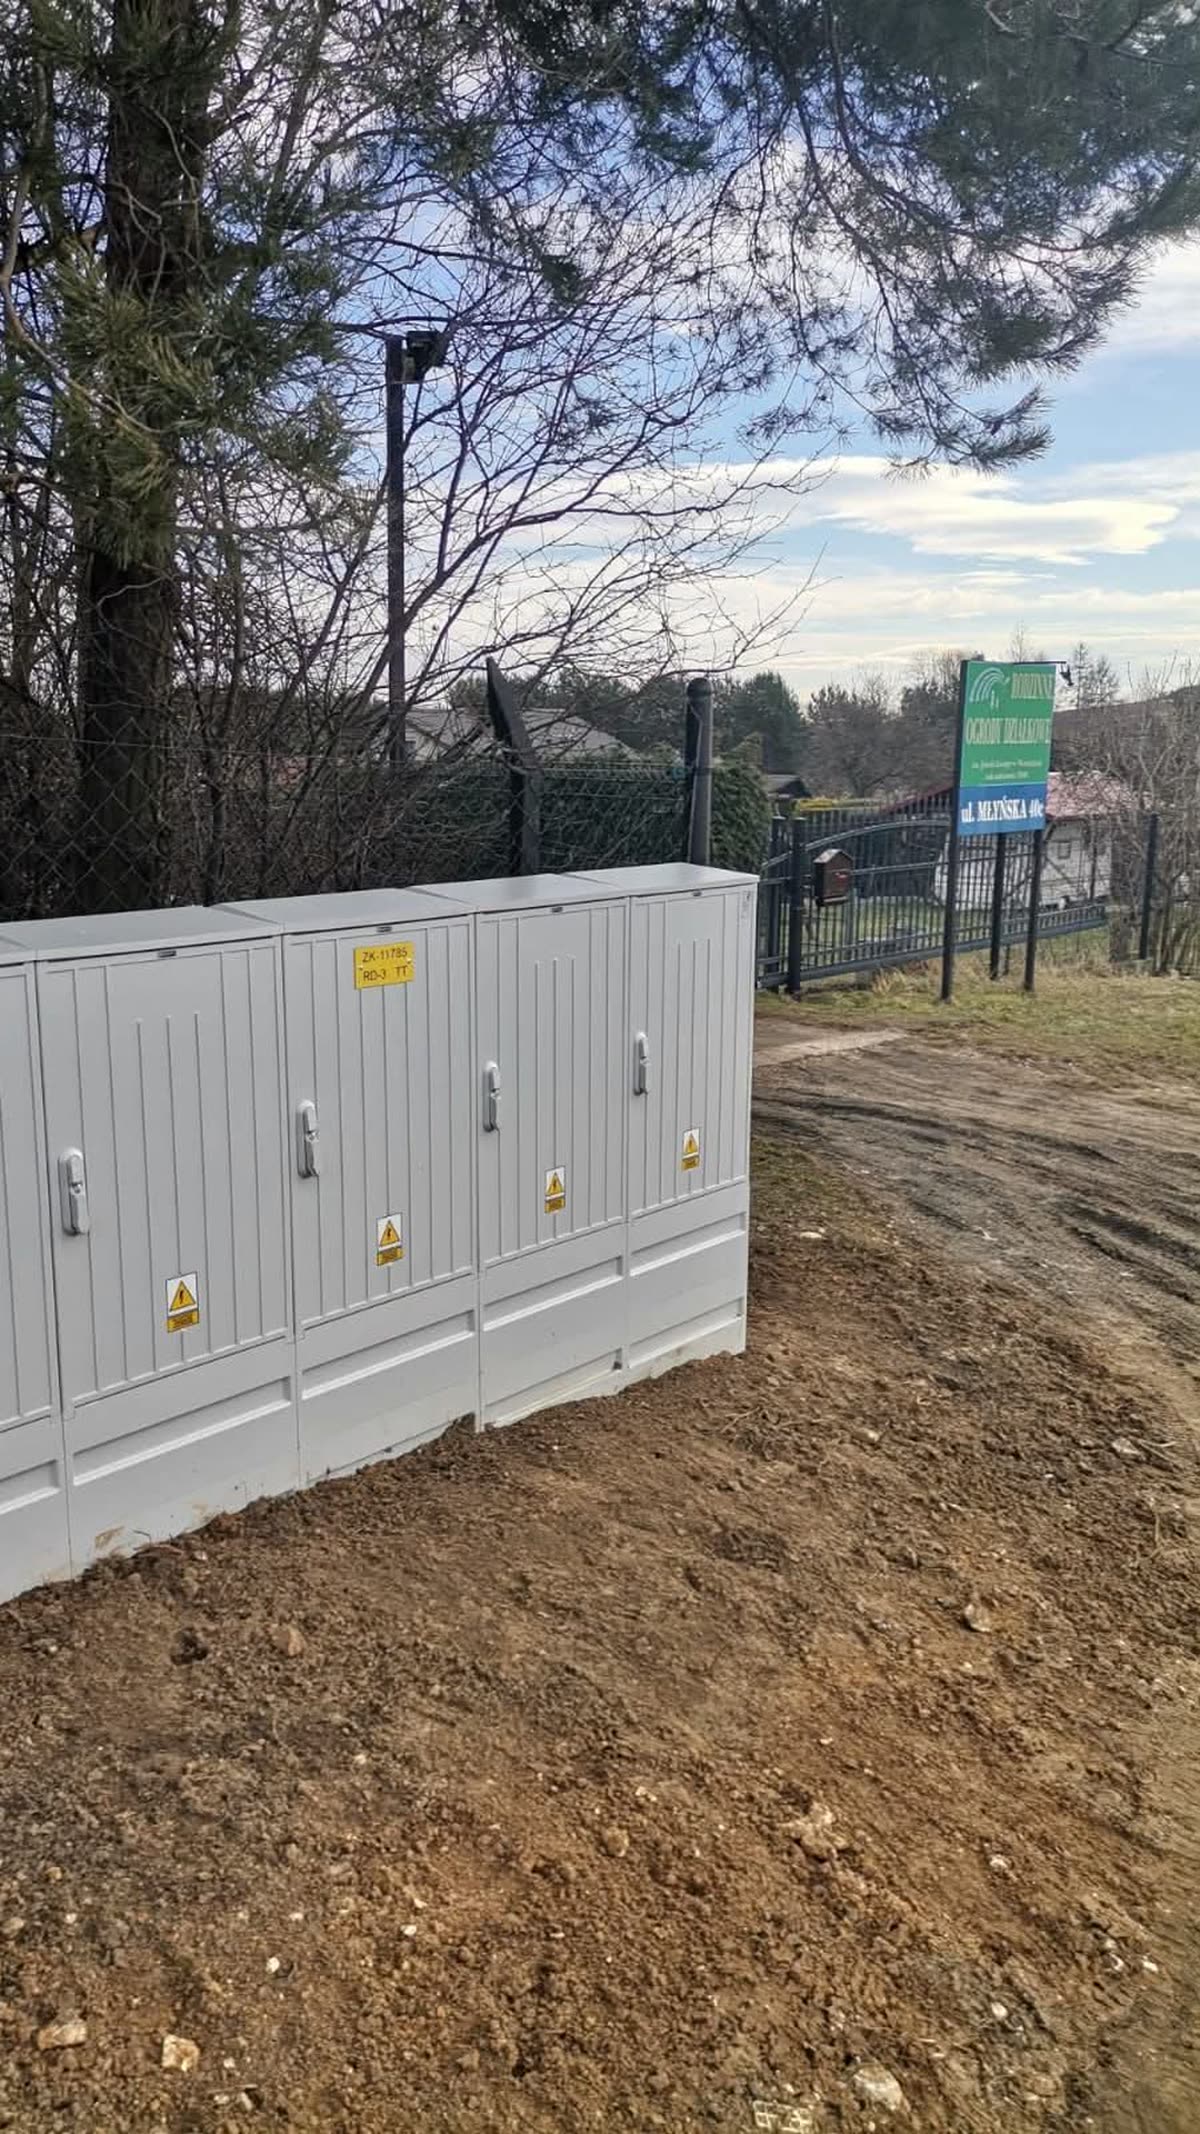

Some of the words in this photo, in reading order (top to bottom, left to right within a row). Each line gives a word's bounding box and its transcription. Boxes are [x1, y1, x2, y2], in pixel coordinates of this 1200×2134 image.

[961, 801, 975, 823] ul.
[977, 795, 1027, 822] MŁYŃSKA
[394, 965, 408, 978] TT
